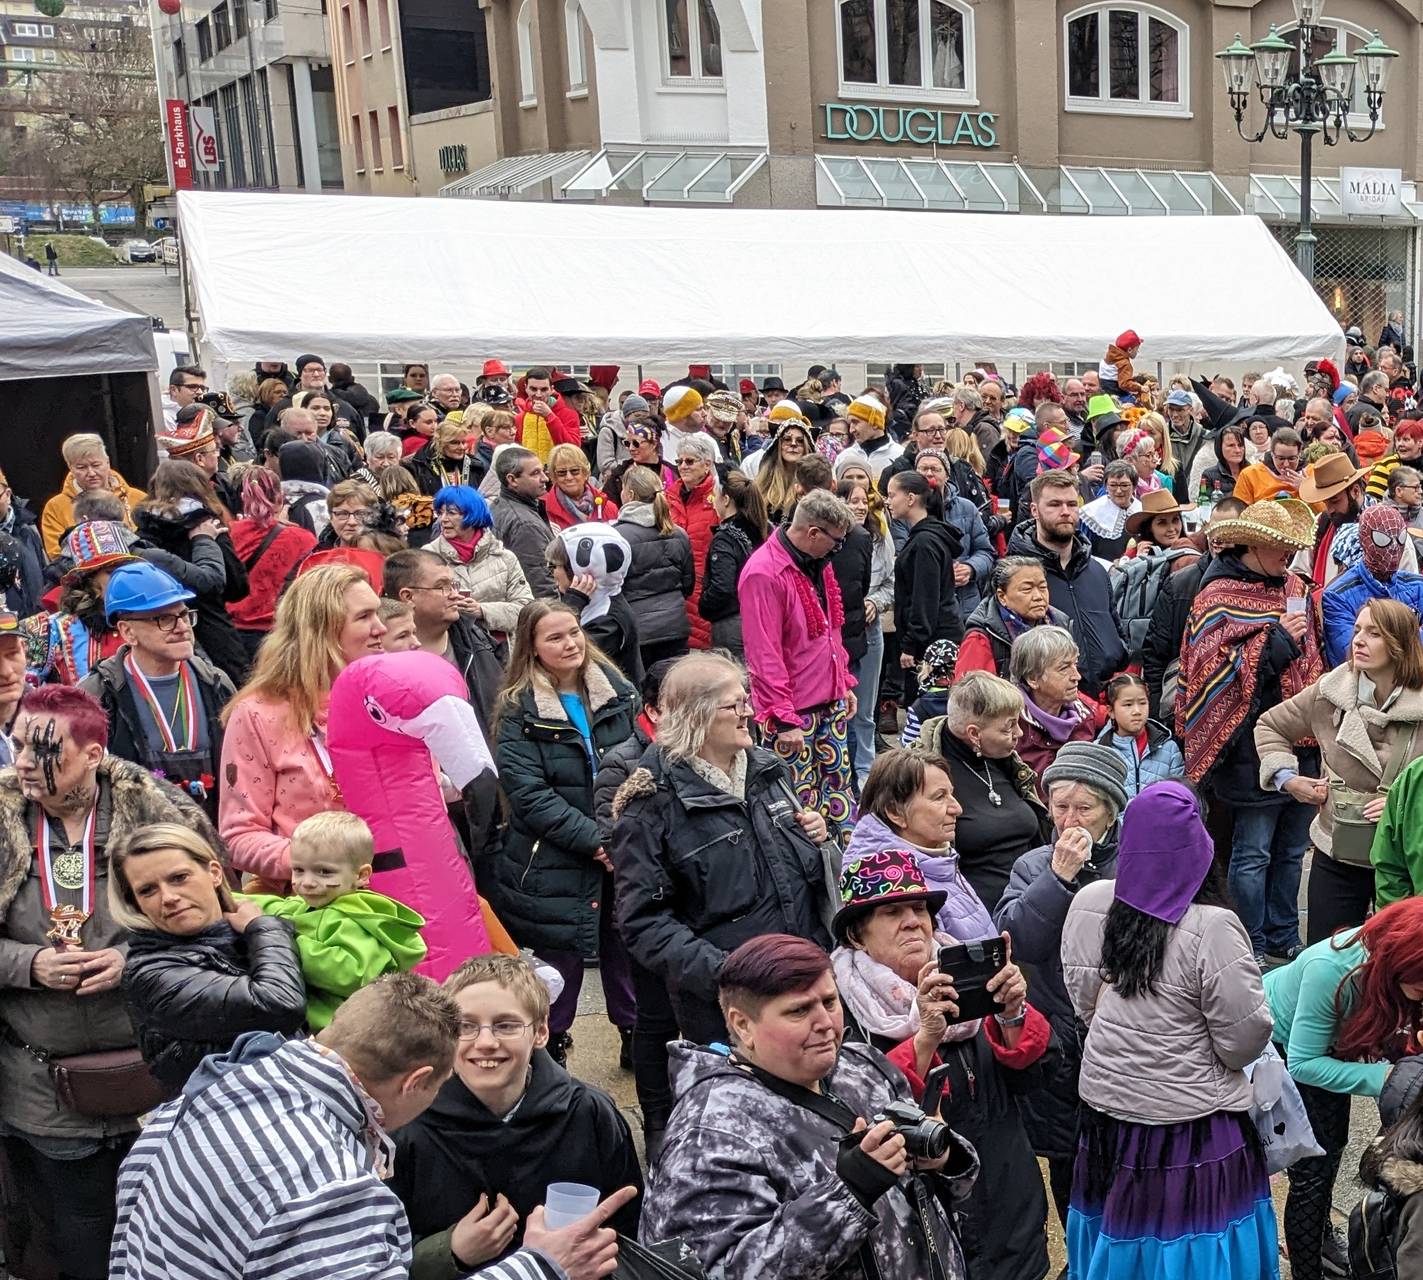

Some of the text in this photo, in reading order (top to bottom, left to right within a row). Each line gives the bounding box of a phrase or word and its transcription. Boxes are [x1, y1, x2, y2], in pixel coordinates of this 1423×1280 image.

[826, 103, 997, 147] DOUGLAS
[203, 135, 218, 165] LBS
[1349, 181, 1396, 195] MALIA
